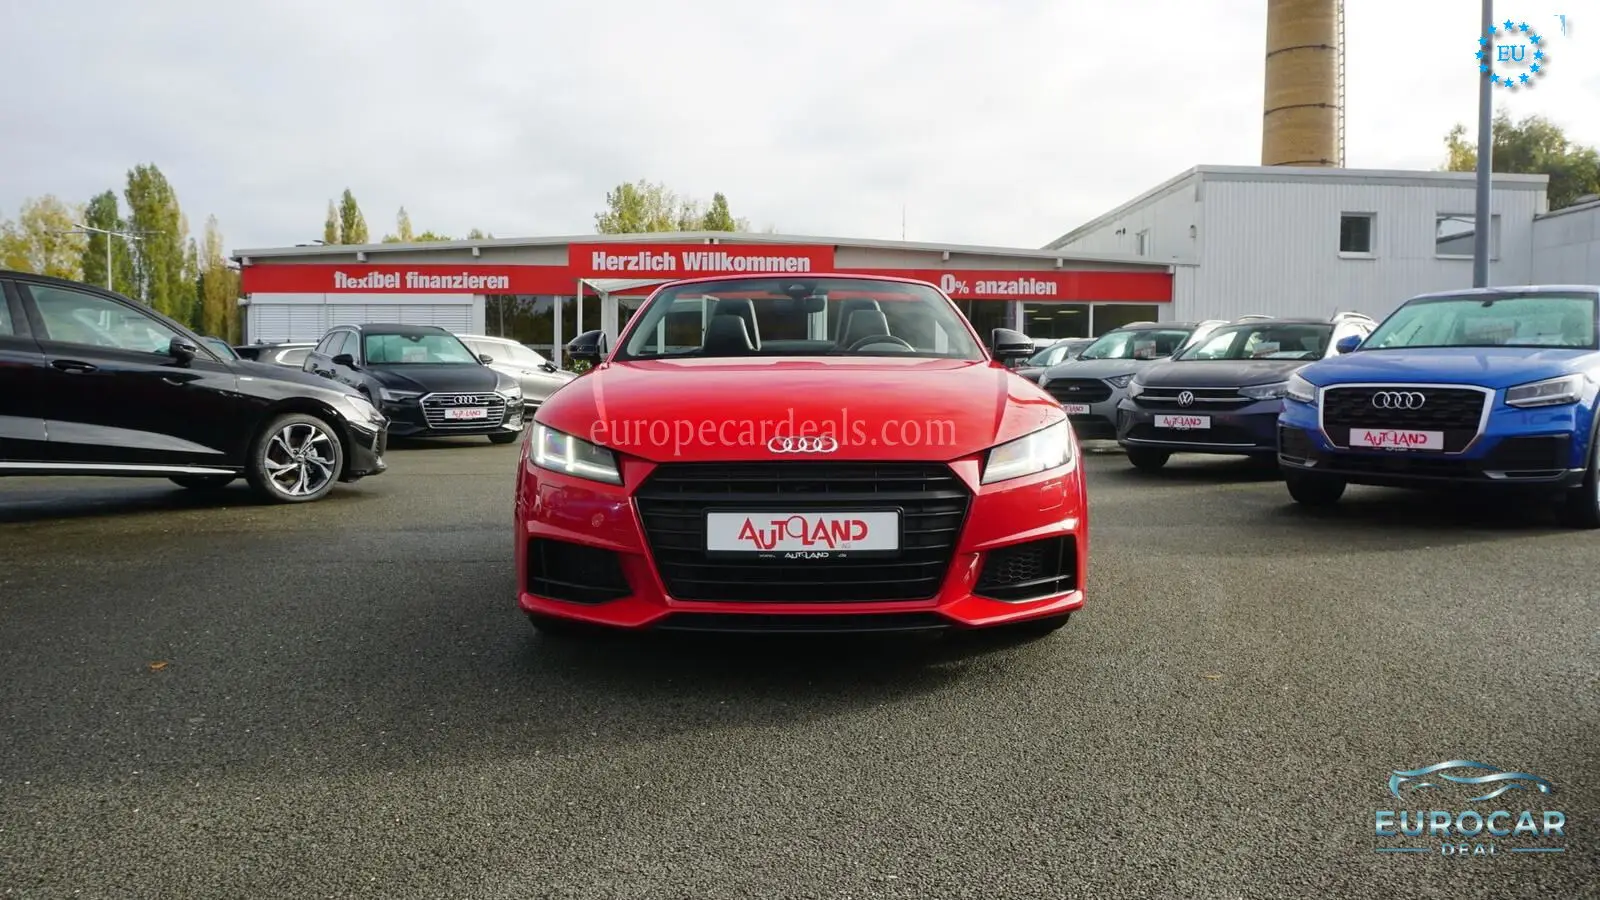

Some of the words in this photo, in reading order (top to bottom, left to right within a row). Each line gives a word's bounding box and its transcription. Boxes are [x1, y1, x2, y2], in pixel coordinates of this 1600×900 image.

[592, 251, 676, 271] Herzlich
[682, 251, 811, 272] Willkommen
[334, 271, 400, 289] flexibel
[405, 271, 509, 289] finanzieren
[940, 273, 970, 294] 0%
[975, 278, 1058, 295] anzahlen
[1364, 431, 1428, 447] AUTOLAND
[738, 515, 868, 550] AUTOLAND
